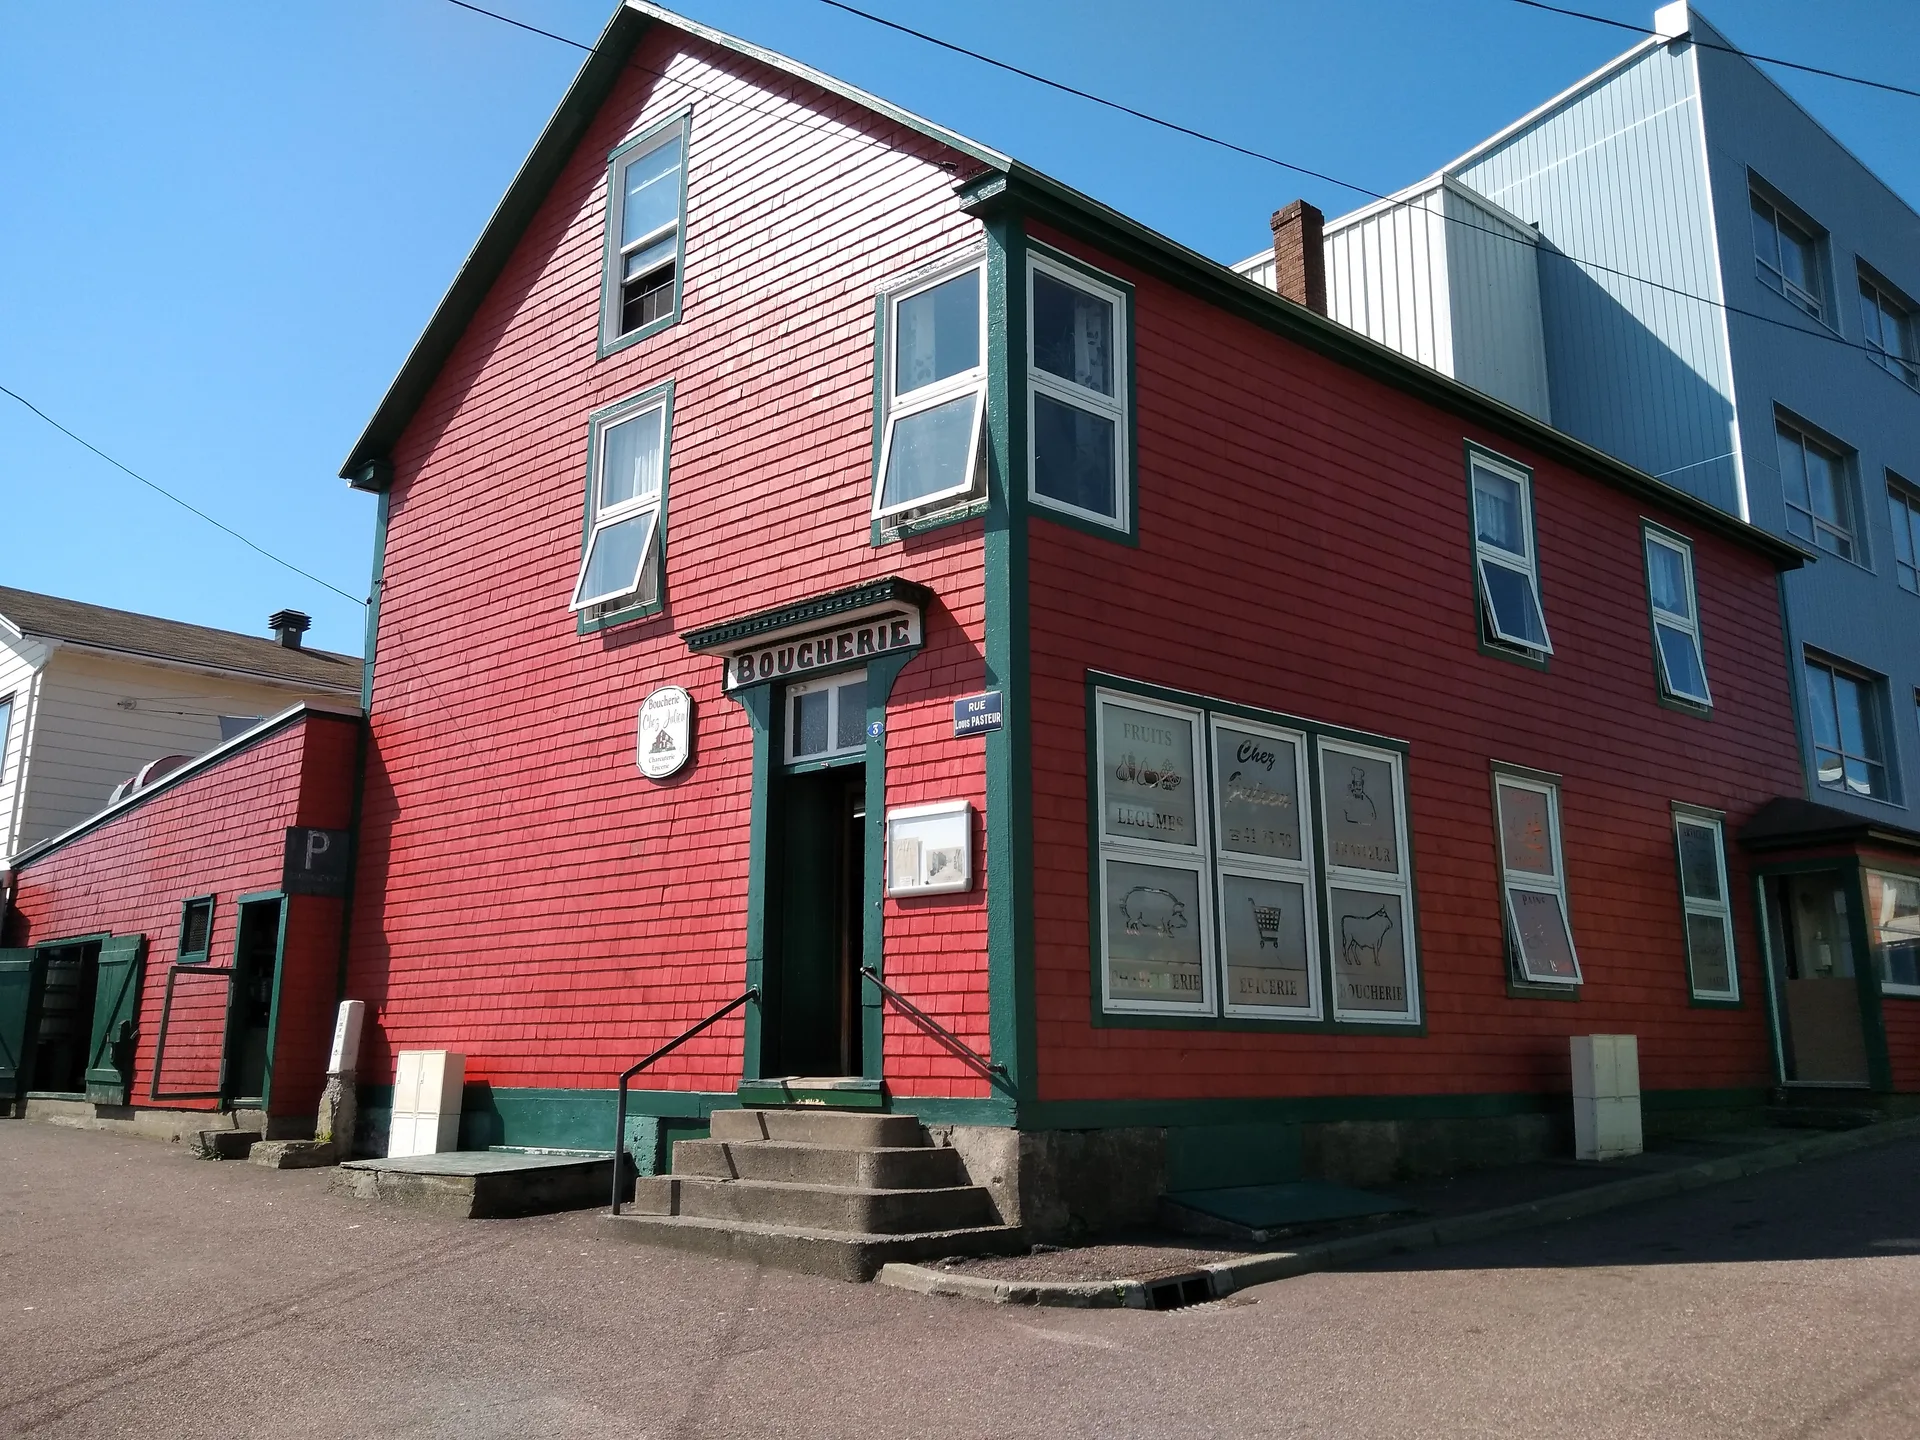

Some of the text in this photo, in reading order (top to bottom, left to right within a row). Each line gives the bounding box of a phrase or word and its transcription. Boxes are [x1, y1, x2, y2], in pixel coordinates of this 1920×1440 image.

[736, 619, 911, 684] BOUCHERIE
[648, 693, 681, 710] Boucherie
[968, 700, 986, 713] RUE
[642, 713, 660, 732] Chez
[872, 723, 879, 735] 3
[971, 712, 1001, 727] PASTEUR
[1123, 722, 1172, 747] FRUITS
[1236, 739, 1276, 772] Chez
[1117, 807, 1184, 832] LEGUMES
[304, 830, 331, 870] P
[1239, 976, 1298, 997] EPICERIE
[1340, 983, 1403, 1001] BOUCHERIE
